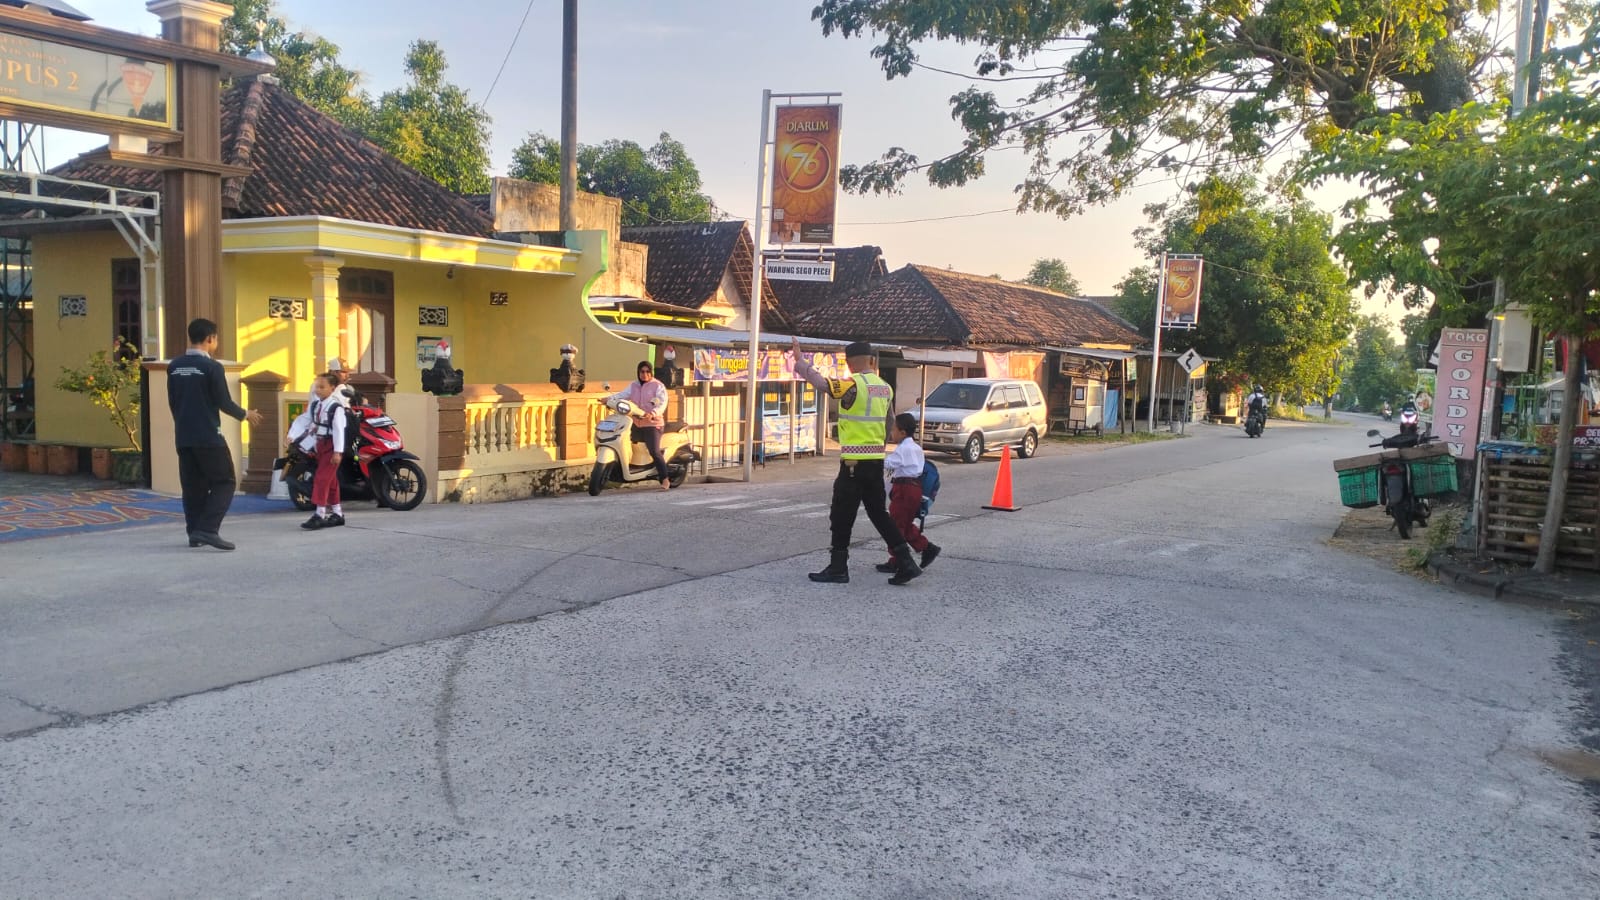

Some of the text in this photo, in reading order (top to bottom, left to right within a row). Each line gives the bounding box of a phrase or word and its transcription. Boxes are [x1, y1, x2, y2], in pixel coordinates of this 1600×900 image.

[67, 71, 80, 91] 2
[786, 120, 830, 133] DJARUM
[767, 265, 795, 274] WARUNG
[796, 266, 812, 275] SEGO
[1446, 331, 1486, 343] TOKO
[1446, 349, 1474, 457] GORDYN
